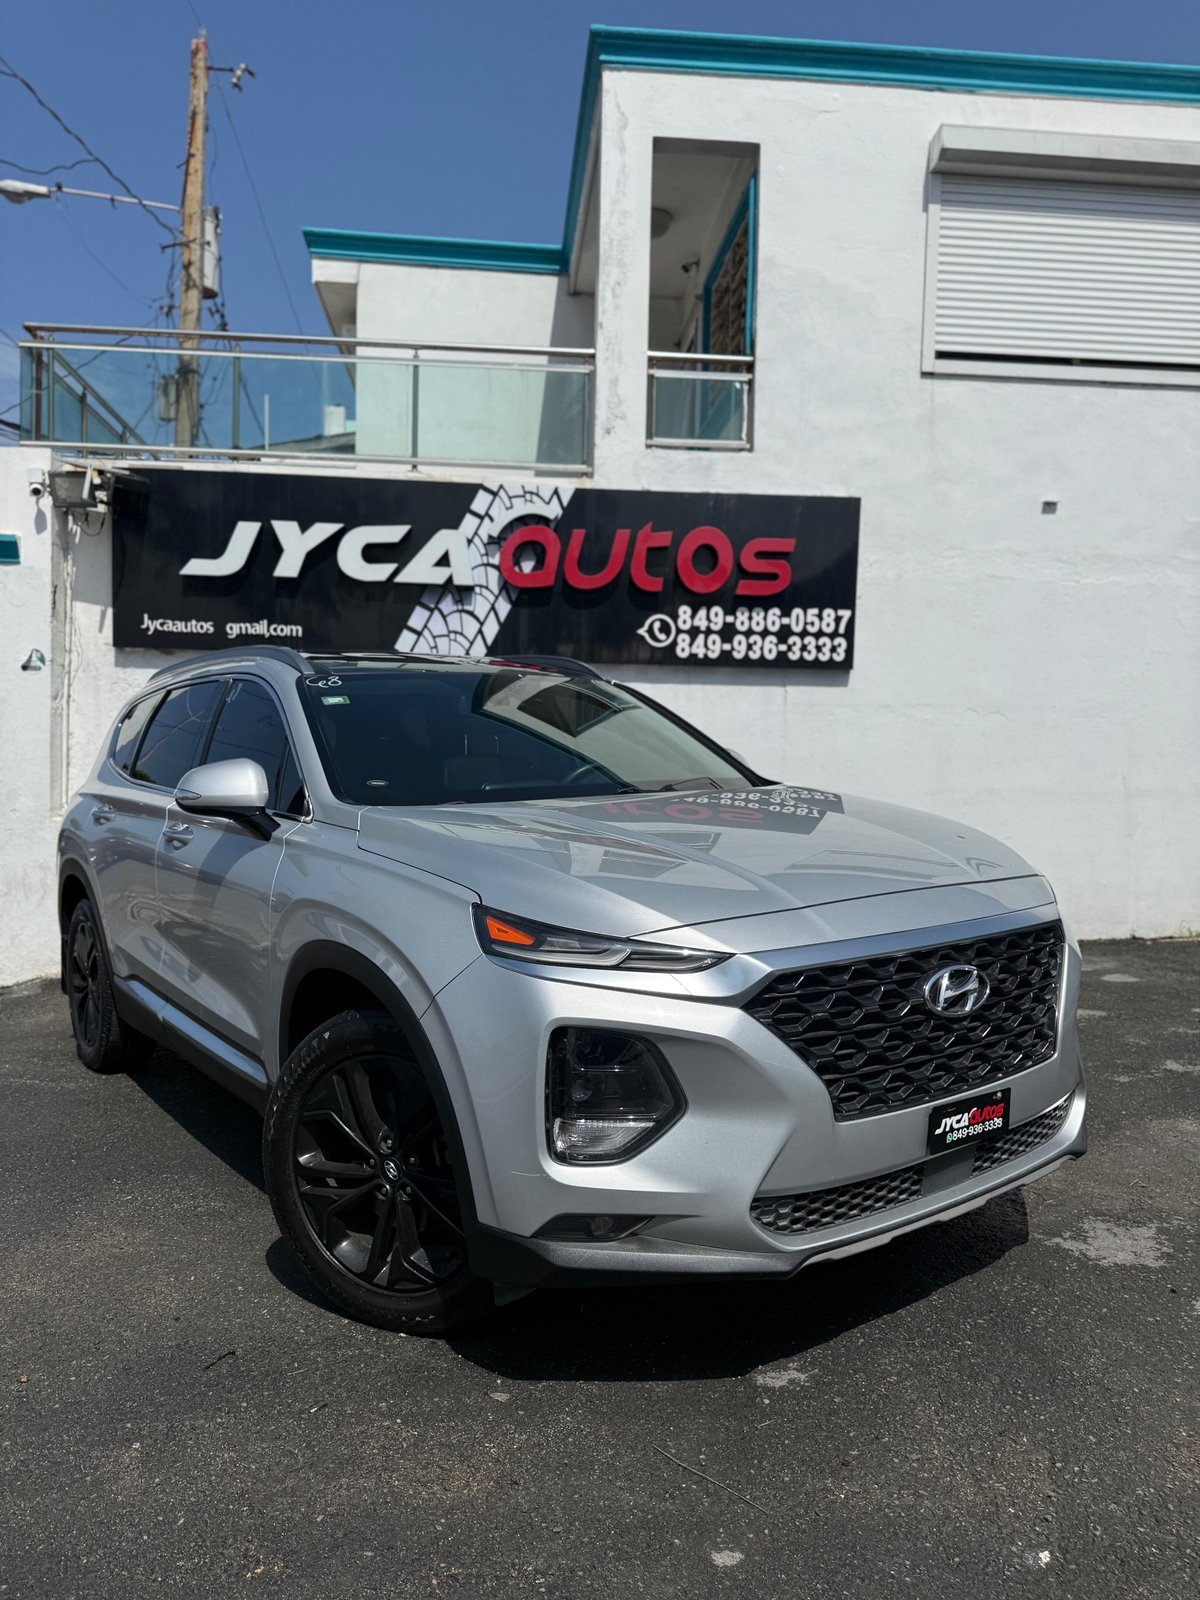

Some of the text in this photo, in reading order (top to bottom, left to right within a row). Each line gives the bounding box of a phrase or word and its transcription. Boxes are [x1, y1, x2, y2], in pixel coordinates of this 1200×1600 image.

[179, 520, 474, 586] JYCA
[140, 613, 214, 635] Jycaautos
[676, 604, 852, 634] 849-886-0587
[675, 633, 848, 662] 849-936-3333
